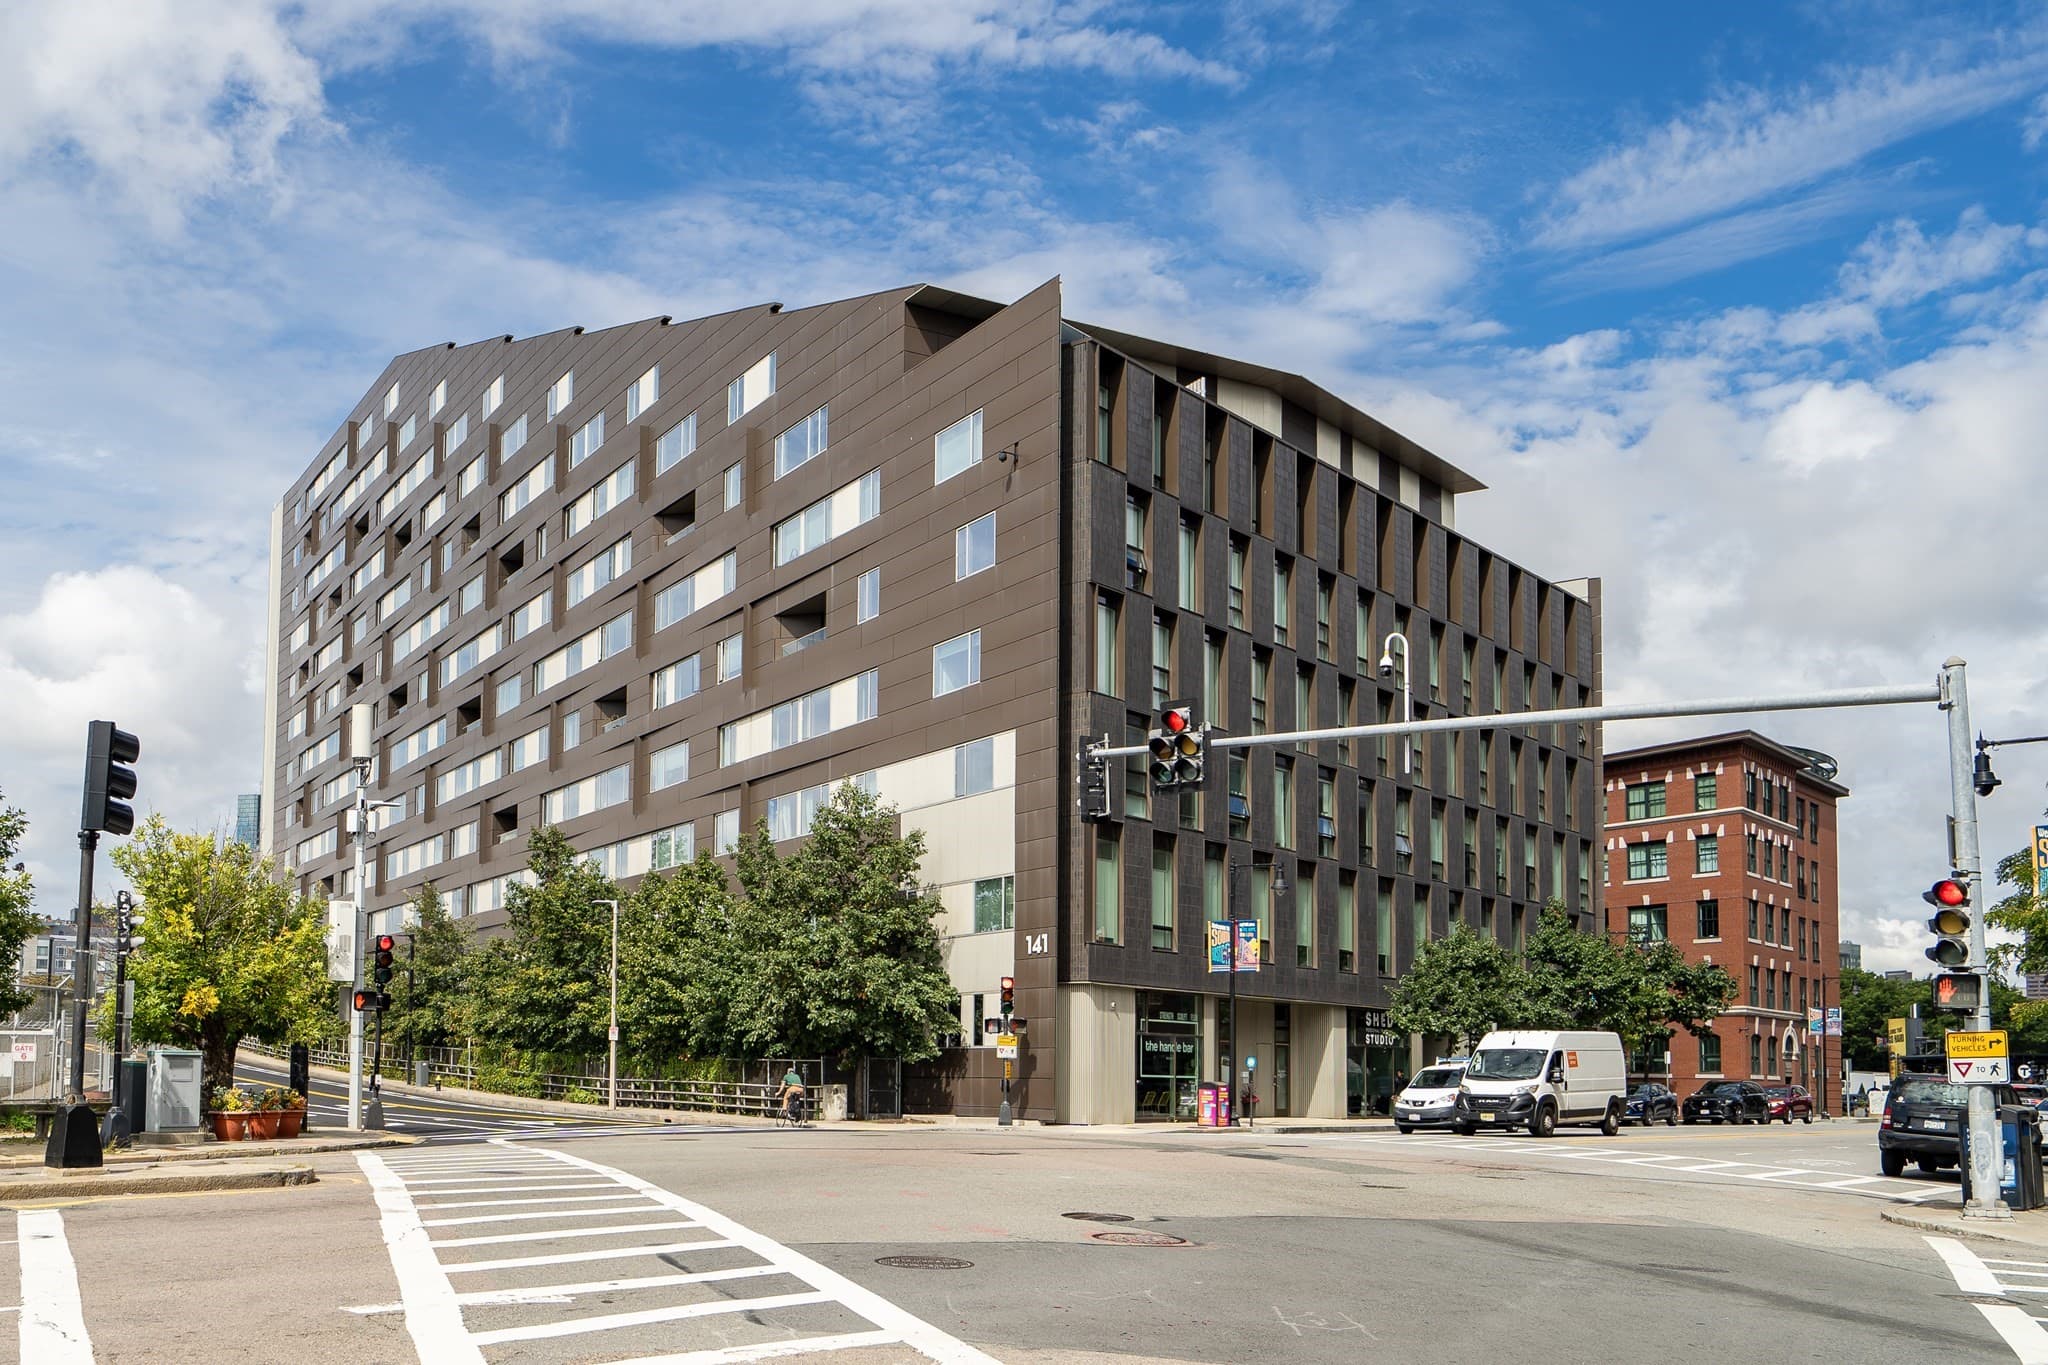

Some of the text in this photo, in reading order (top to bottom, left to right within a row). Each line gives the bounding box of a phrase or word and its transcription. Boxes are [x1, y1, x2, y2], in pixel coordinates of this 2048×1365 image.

[1025, 933, 1048, 955] 141
[1365, 1033, 1394, 1046] STUDIO
[1951, 1035, 1985, 1043] TURNING
[1145, 1040, 1158, 1052] the
[1182, 1041, 1194, 1053] bar
